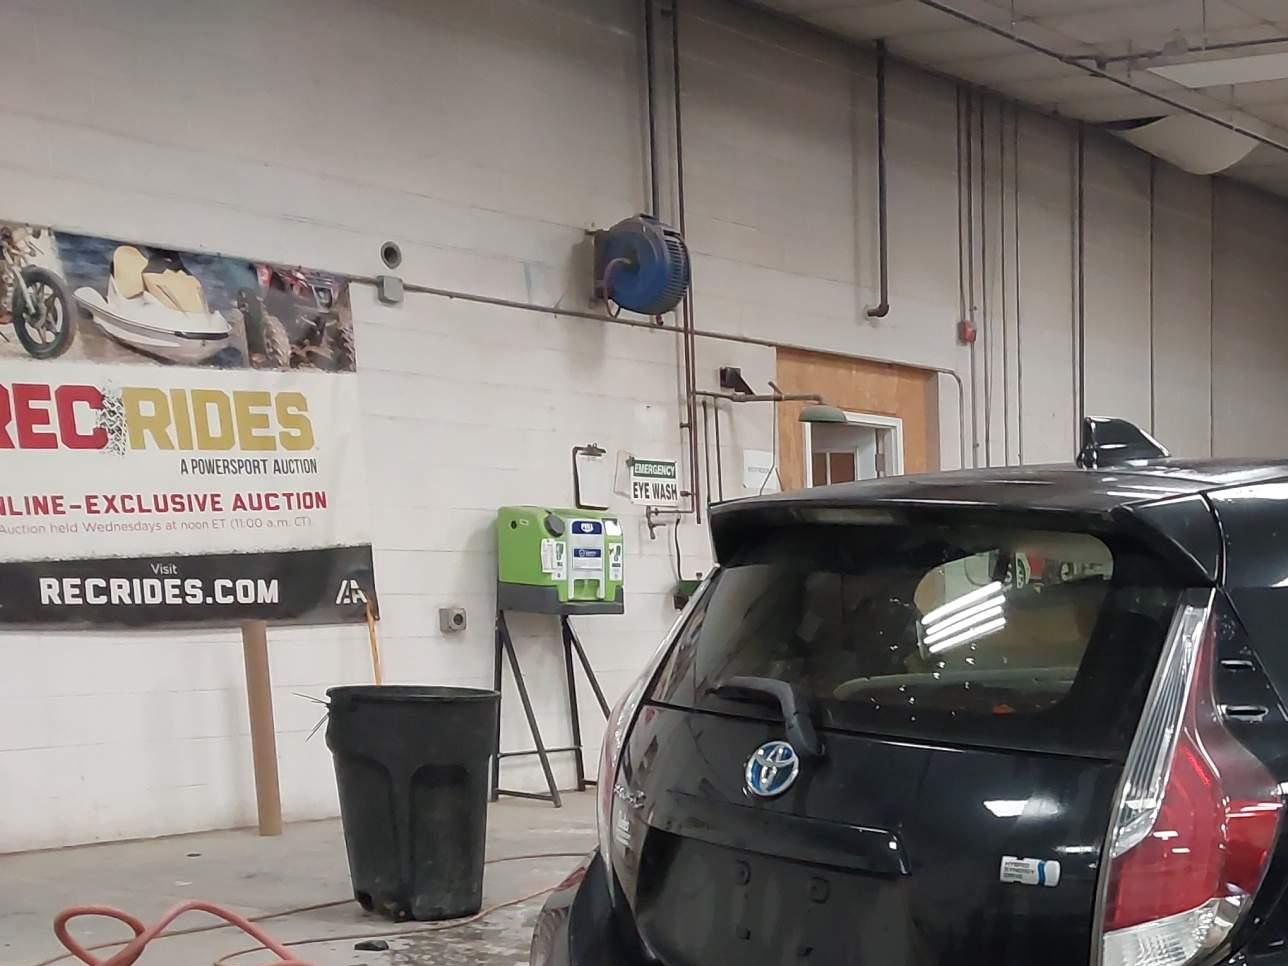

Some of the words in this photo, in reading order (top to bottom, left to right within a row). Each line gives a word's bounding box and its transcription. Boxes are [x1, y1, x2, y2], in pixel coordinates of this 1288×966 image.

[0, 383, 109, 450] EC
[121, 386, 316, 451] RIDES
[181, 459, 189, 475] A
[191, 458, 269, 475] POWERSPORT
[273, 458, 318, 475] AUCTION
[634, 463, 676, 477] EMERGENCY
[632, 481, 651, 500] EYE
[651, 482, 679, 501] WASH
[232, 491, 328, 512] AUCTION
[49, 522, 78, 534] held
[82, 520, 162, 533] Wednesdays
[165, 520, 177, 531] at
[181, 519, 209, 530] noon
[212, 518, 226, 529] ET
[150, 562, 178, 575] Visit
[38, 576, 280, 605] RECRIDES.COM
